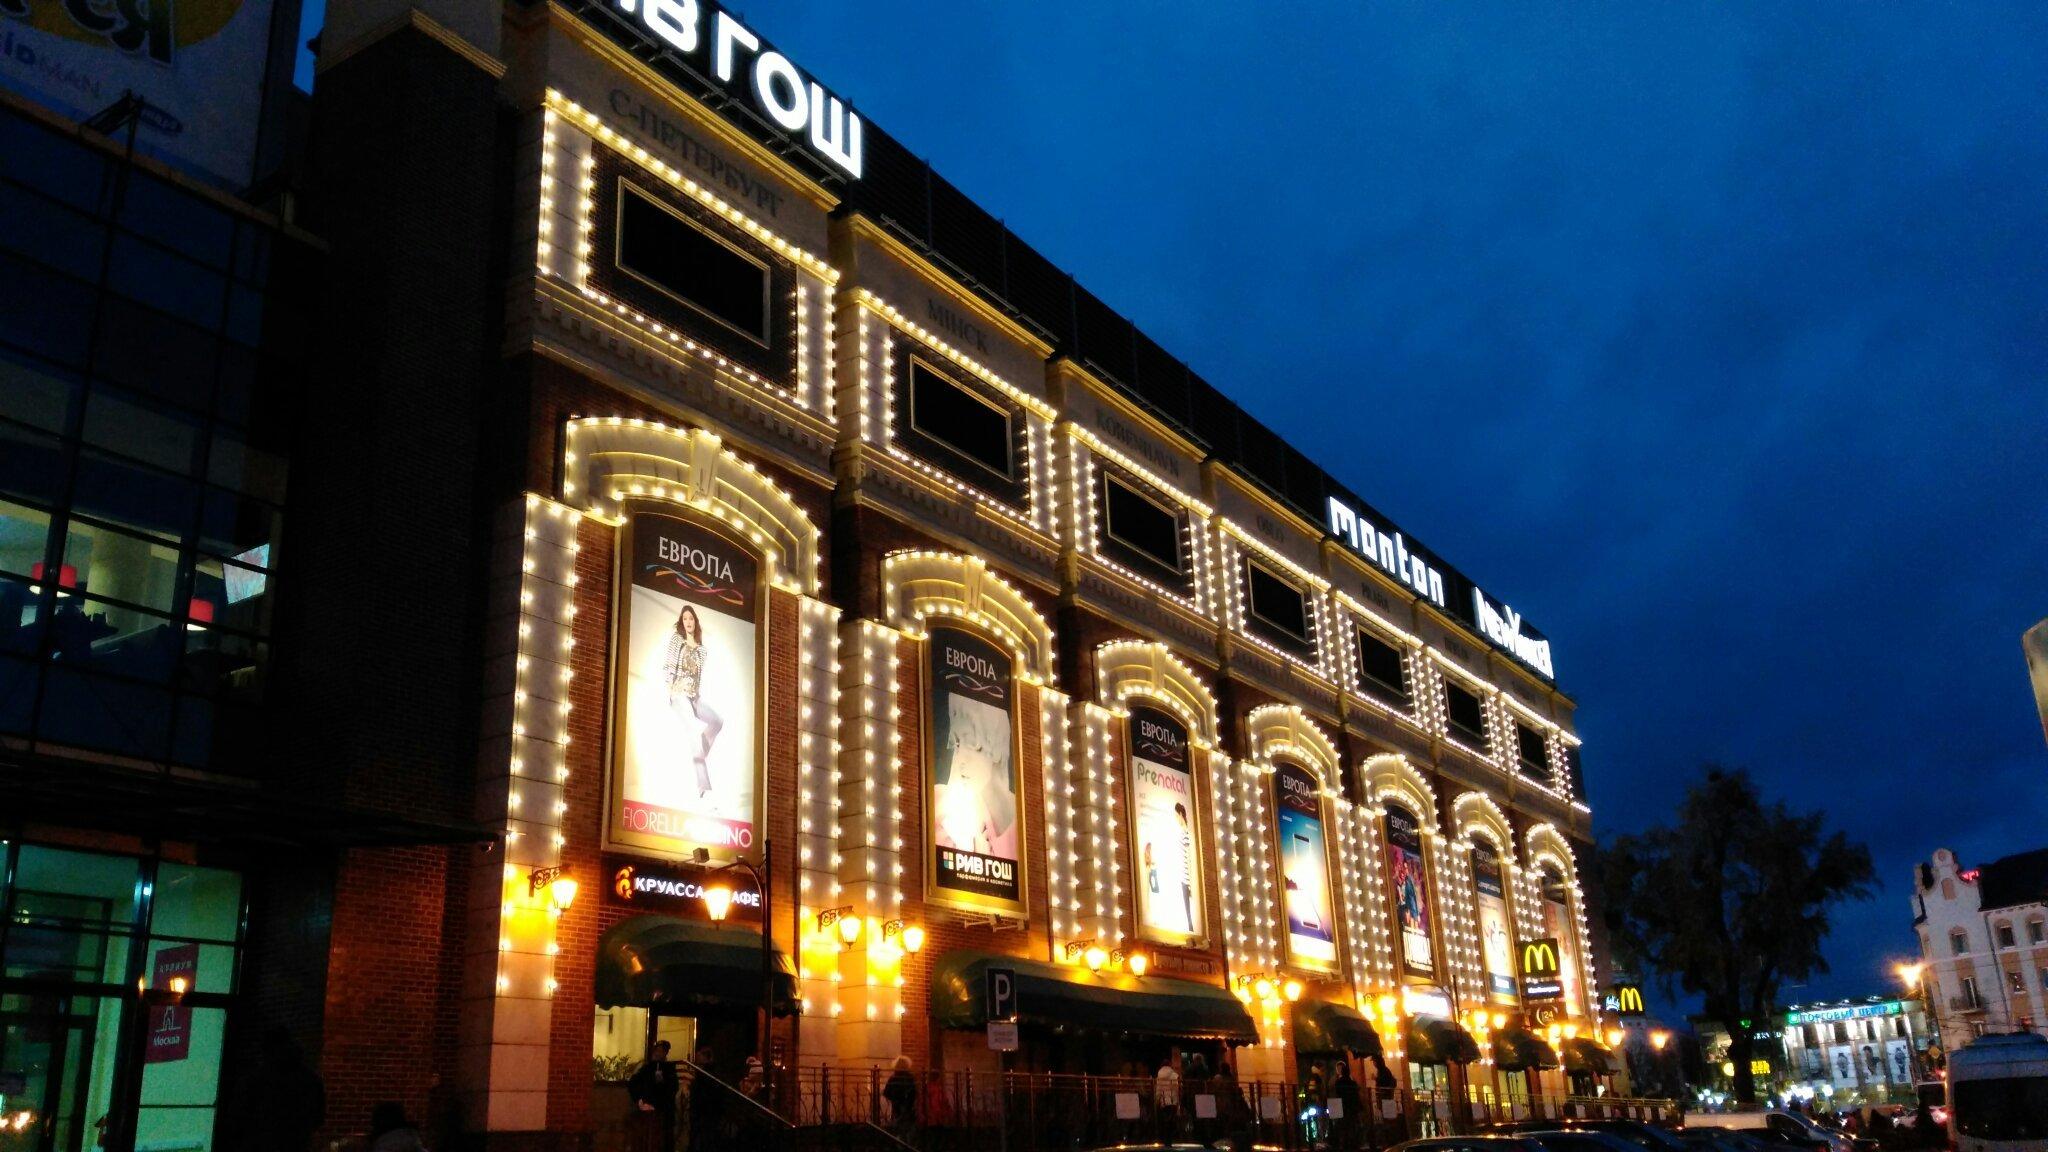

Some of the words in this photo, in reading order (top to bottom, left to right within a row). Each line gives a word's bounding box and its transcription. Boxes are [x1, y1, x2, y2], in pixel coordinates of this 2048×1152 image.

[717, 10, 861, 180] ГОШ
[658, 536, 734, 583] ЕВРОПА
[1329, 496, 1445, 607] monton
[945, 646, 997, 681] ЕВРОПА
[1140, 720, 1178, 747] ЕВРОПА
[1282, 774, 1311, 798] ЕВРОПА
[623, 807, 692, 837] FIORELL
[955, 853, 984, 875] РИВ
[985, 859, 1013, 881] ГОШ
[634, 877, 712, 901] КРУАССА
[724, 889, 761, 907] АФЕ
[995, 973, 1011, 1015] P
[1543, 1010, 1554, 1019] 24
[1800, 1007, 1854, 1023] ТОРГОВЫЙ
[153, 1035, 181, 1046] Москва
